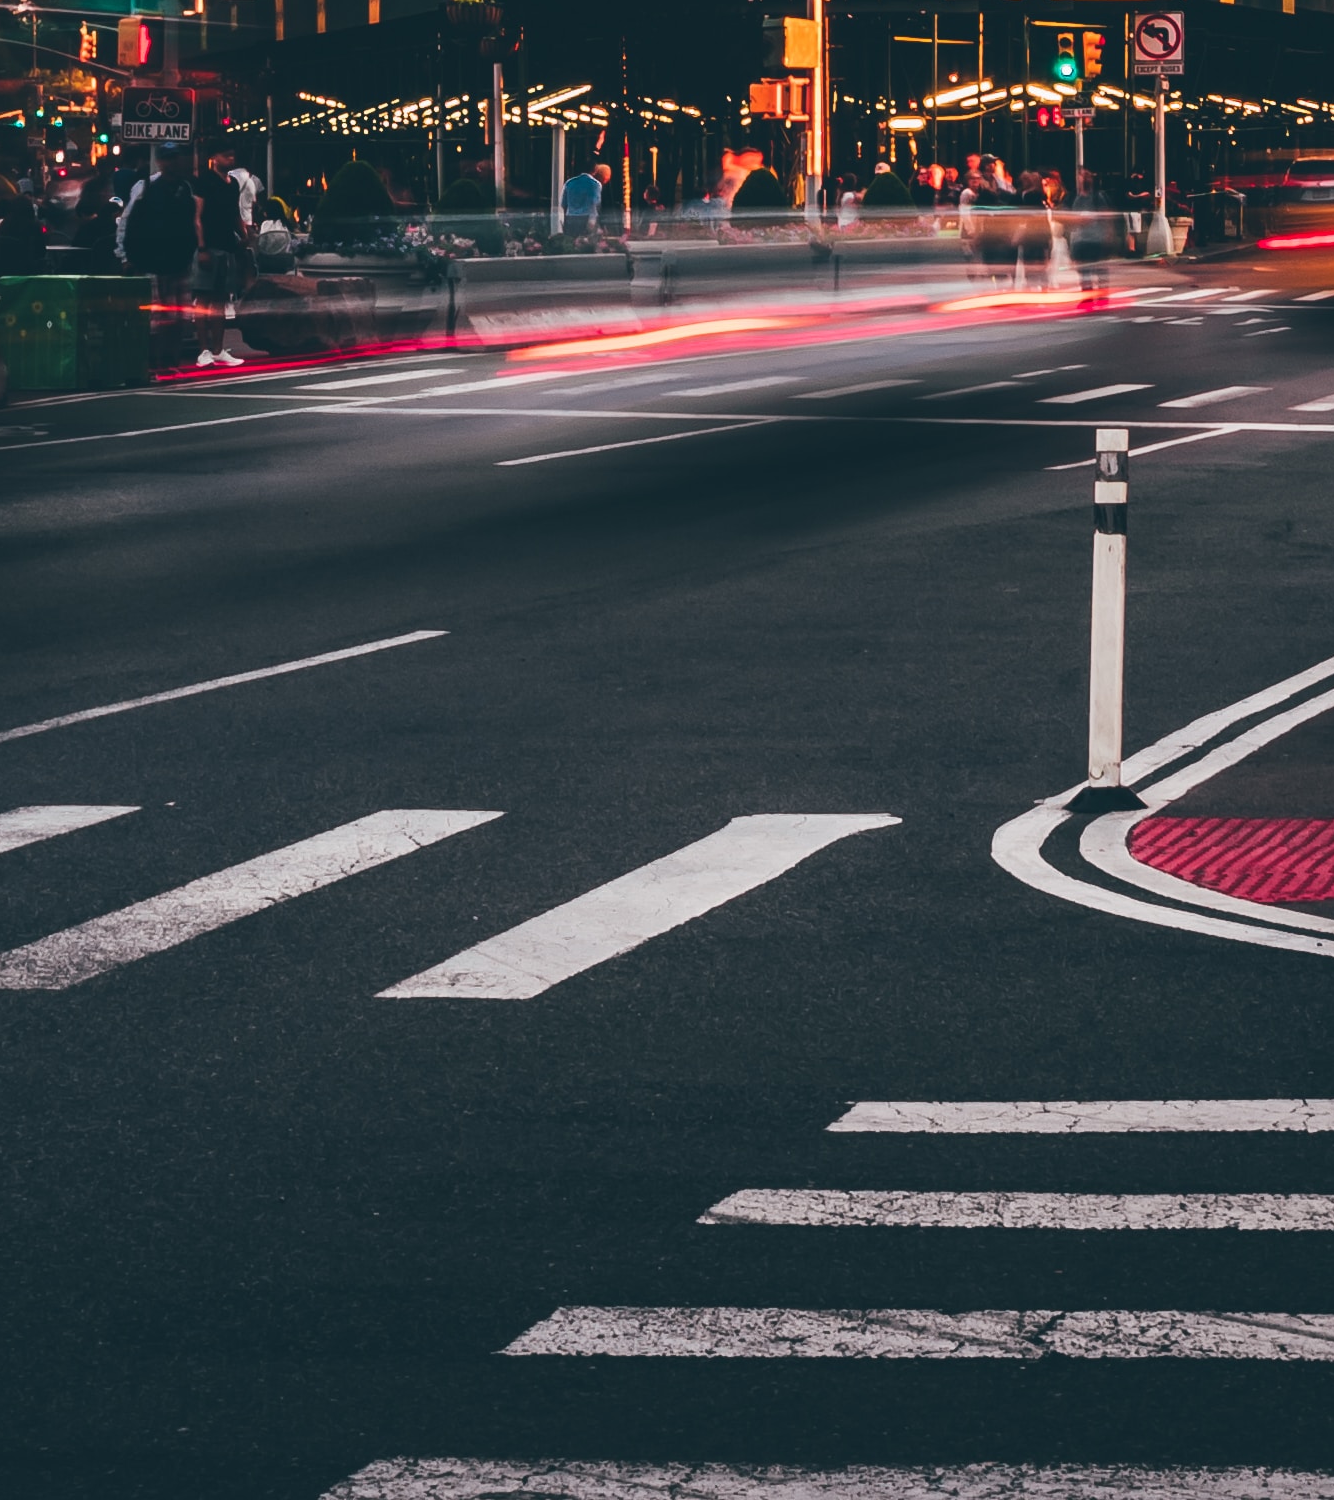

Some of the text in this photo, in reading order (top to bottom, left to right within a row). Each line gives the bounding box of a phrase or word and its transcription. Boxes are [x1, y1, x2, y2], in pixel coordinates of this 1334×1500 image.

[1160, 65, 1181, 73] BUSES
[125, 123, 189, 139] BIKE LANE
